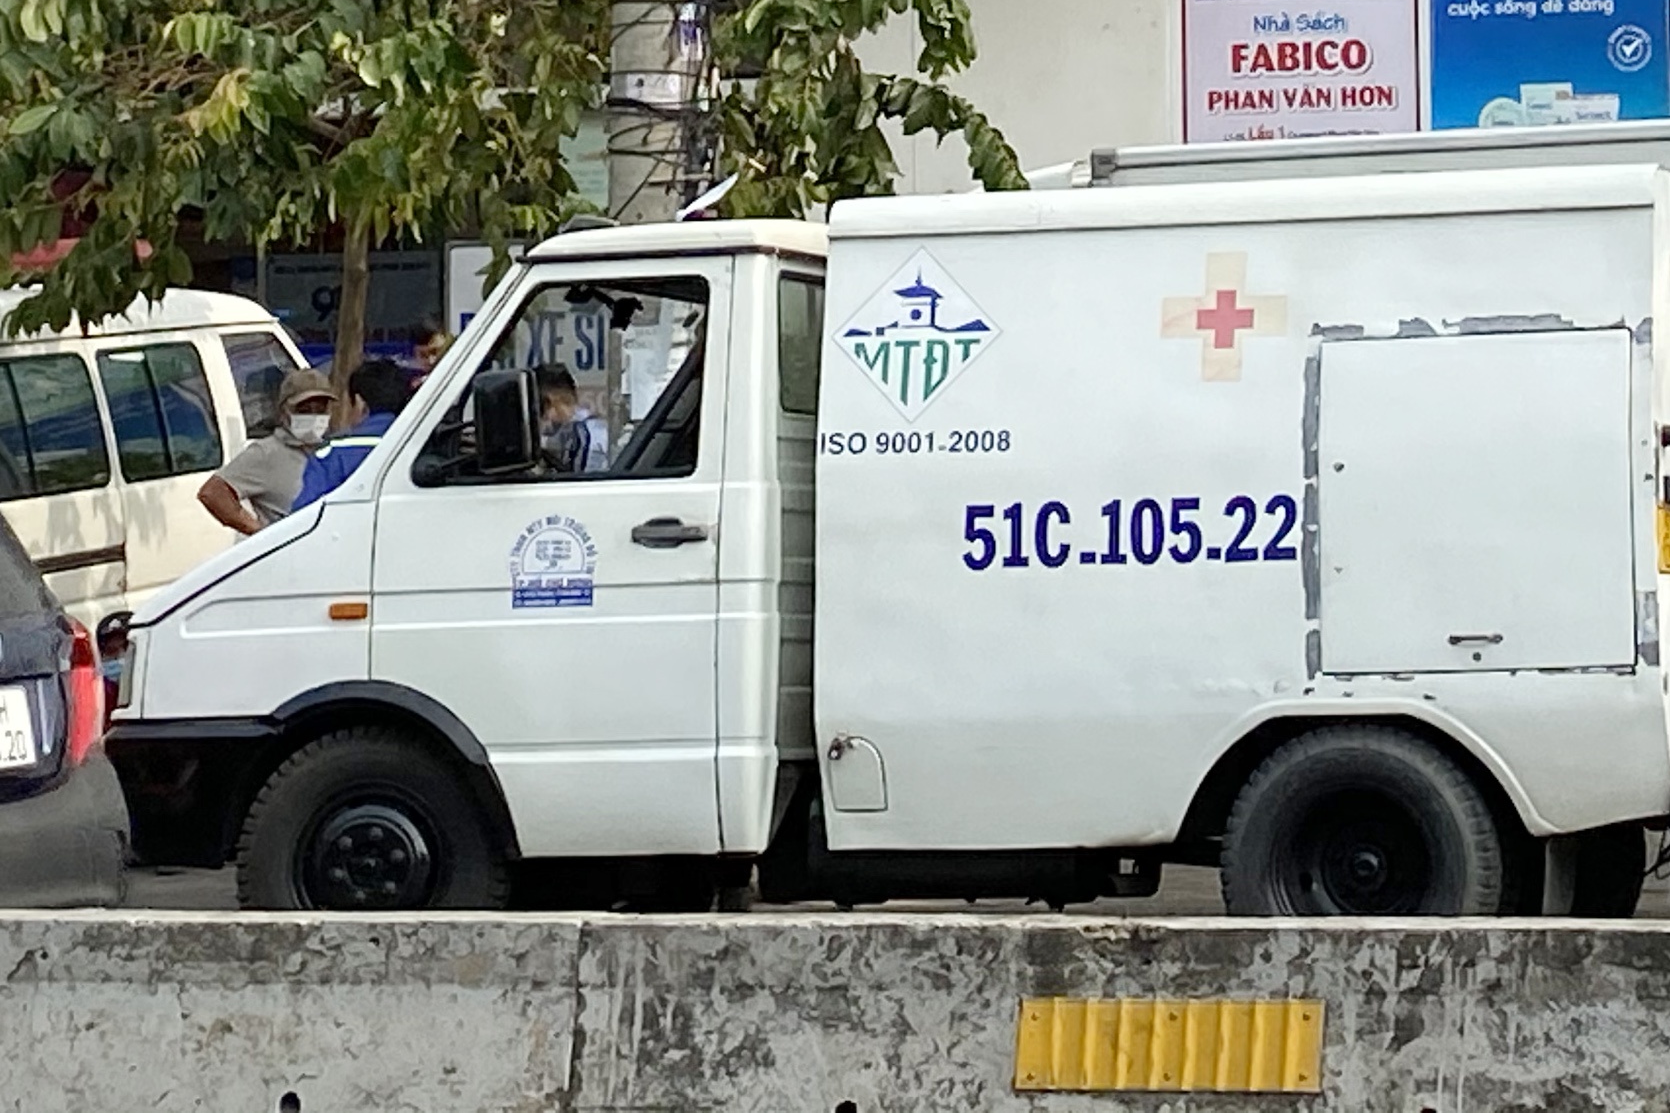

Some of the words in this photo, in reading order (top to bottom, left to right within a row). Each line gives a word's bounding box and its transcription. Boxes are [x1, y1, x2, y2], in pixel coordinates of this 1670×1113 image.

[1253, 11, 1290, 32] Nhà
[1296, 9, 1346, 33] Sách
[1231, 38, 1367, 73] FABICO
[1207, 89, 1274, 112] PHAN
[1282, 83, 1332, 109] VĂN
[819, 433, 867, 456] ISO
[962, 494, 1299, 572] 51C.105.22
